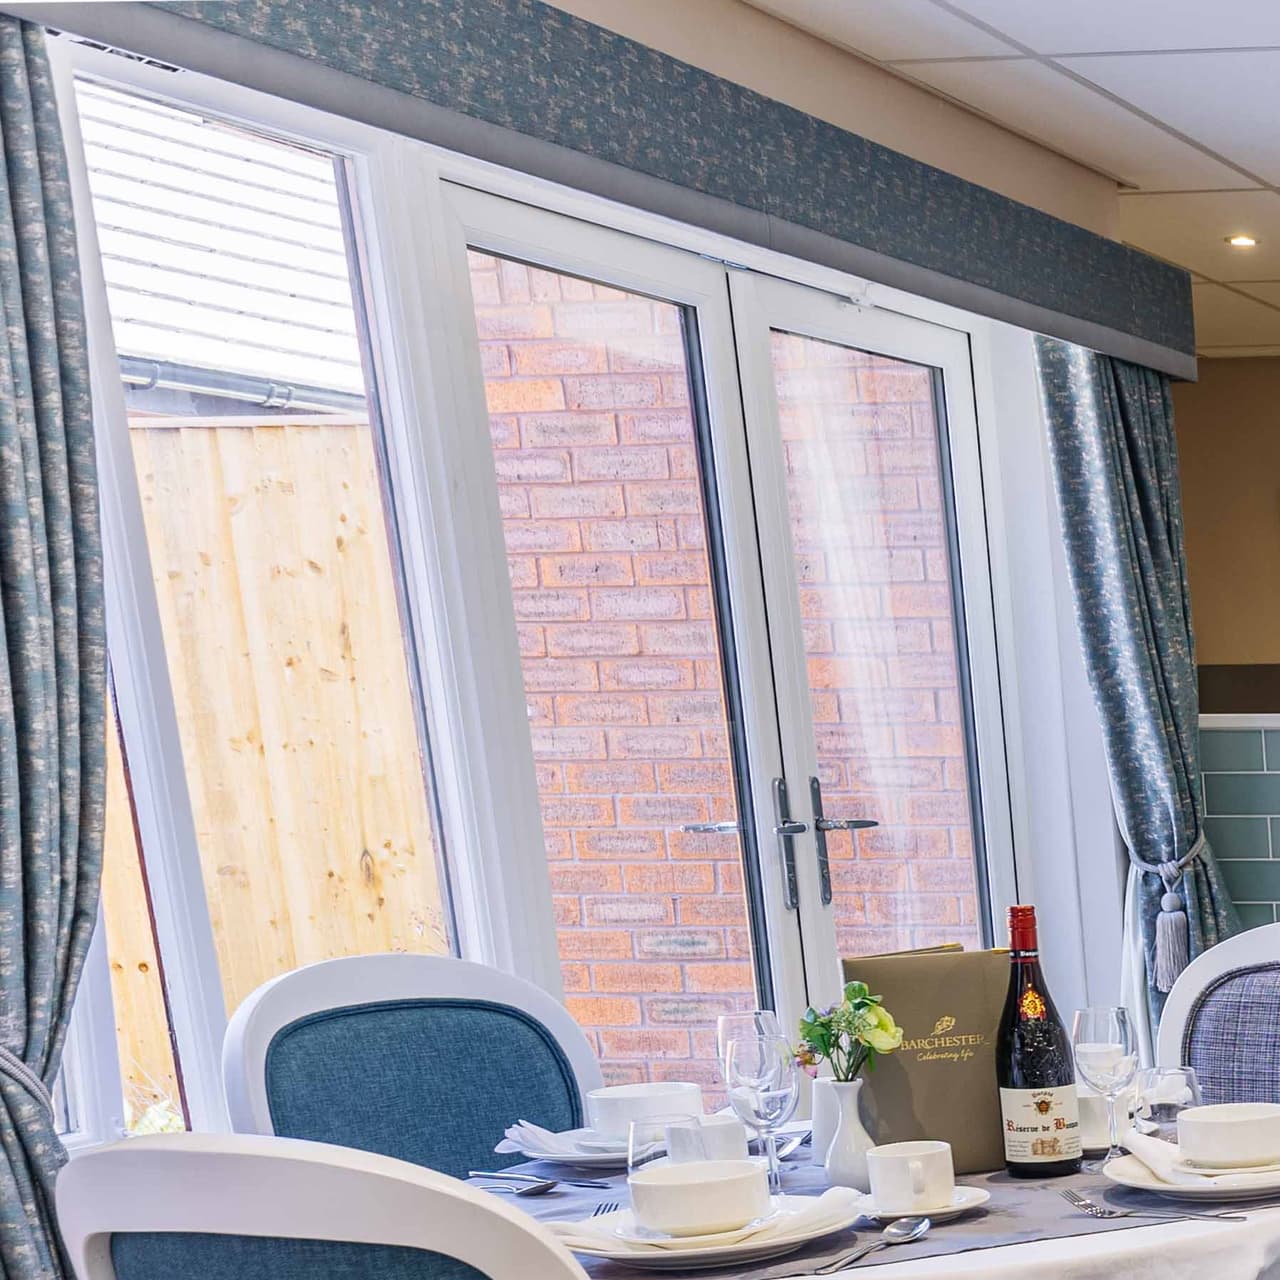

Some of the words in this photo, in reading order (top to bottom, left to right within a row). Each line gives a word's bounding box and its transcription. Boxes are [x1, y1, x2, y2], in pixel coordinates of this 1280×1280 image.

[901, 1034, 990, 1050] BARCHESTER
[917, 1050, 960, 1062] Celebrating
[960, 1047, 975, 1061] life
